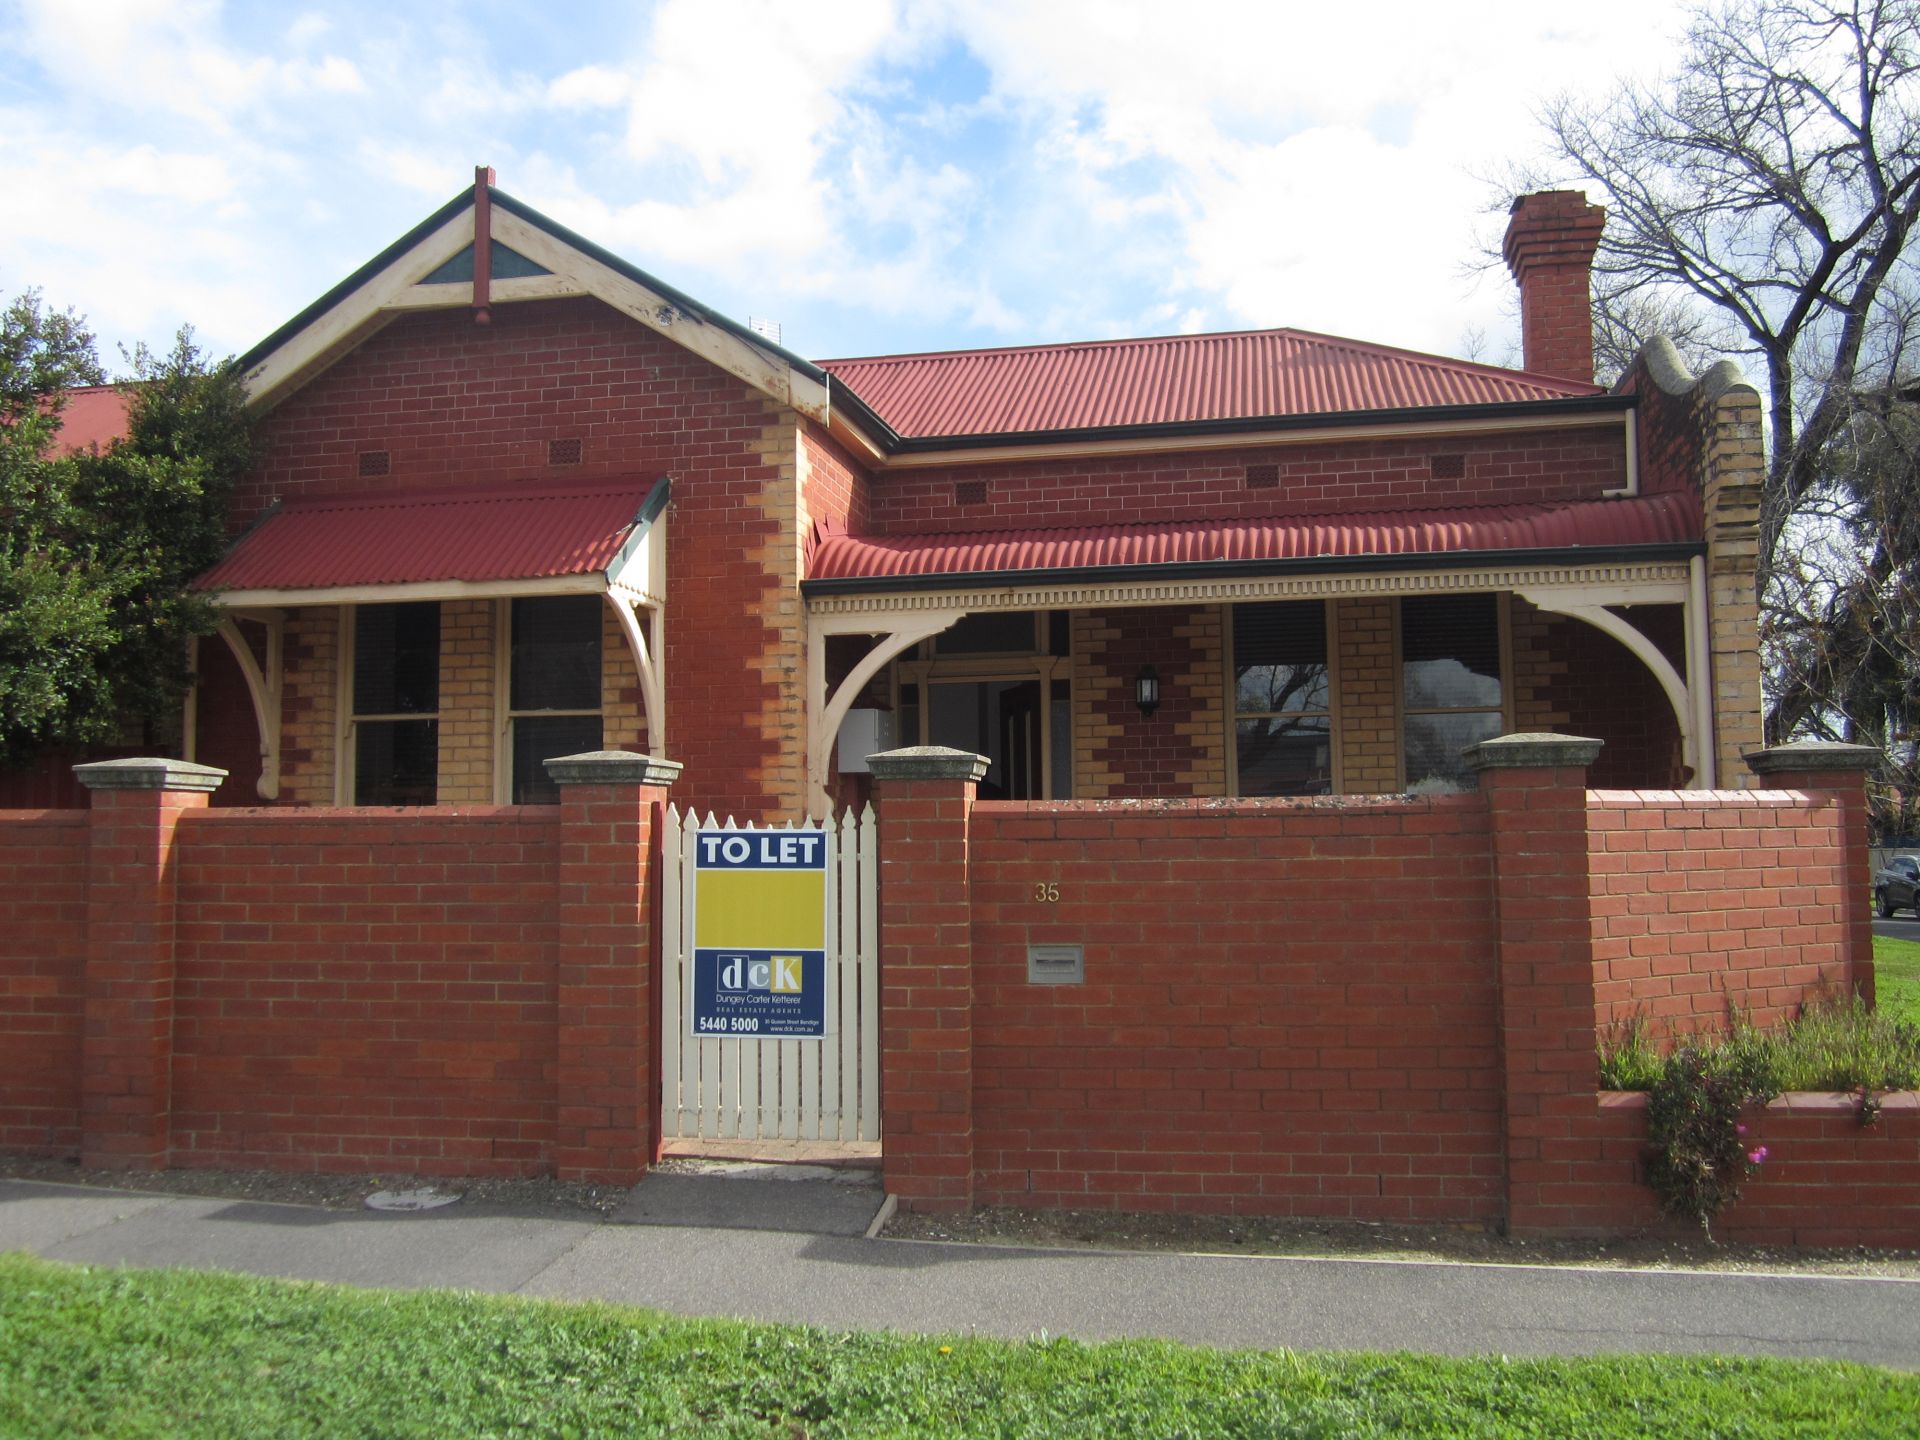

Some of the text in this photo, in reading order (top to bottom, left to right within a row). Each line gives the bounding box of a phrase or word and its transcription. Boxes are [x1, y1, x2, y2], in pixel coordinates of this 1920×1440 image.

[702, 836, 818, 863] TO LET
[1035, 882, 1060, 902] 35
[716, 994, 801, 1005] Dungey Carter Ketterer
[700, 1016, 759, 1031] 5440 5000
